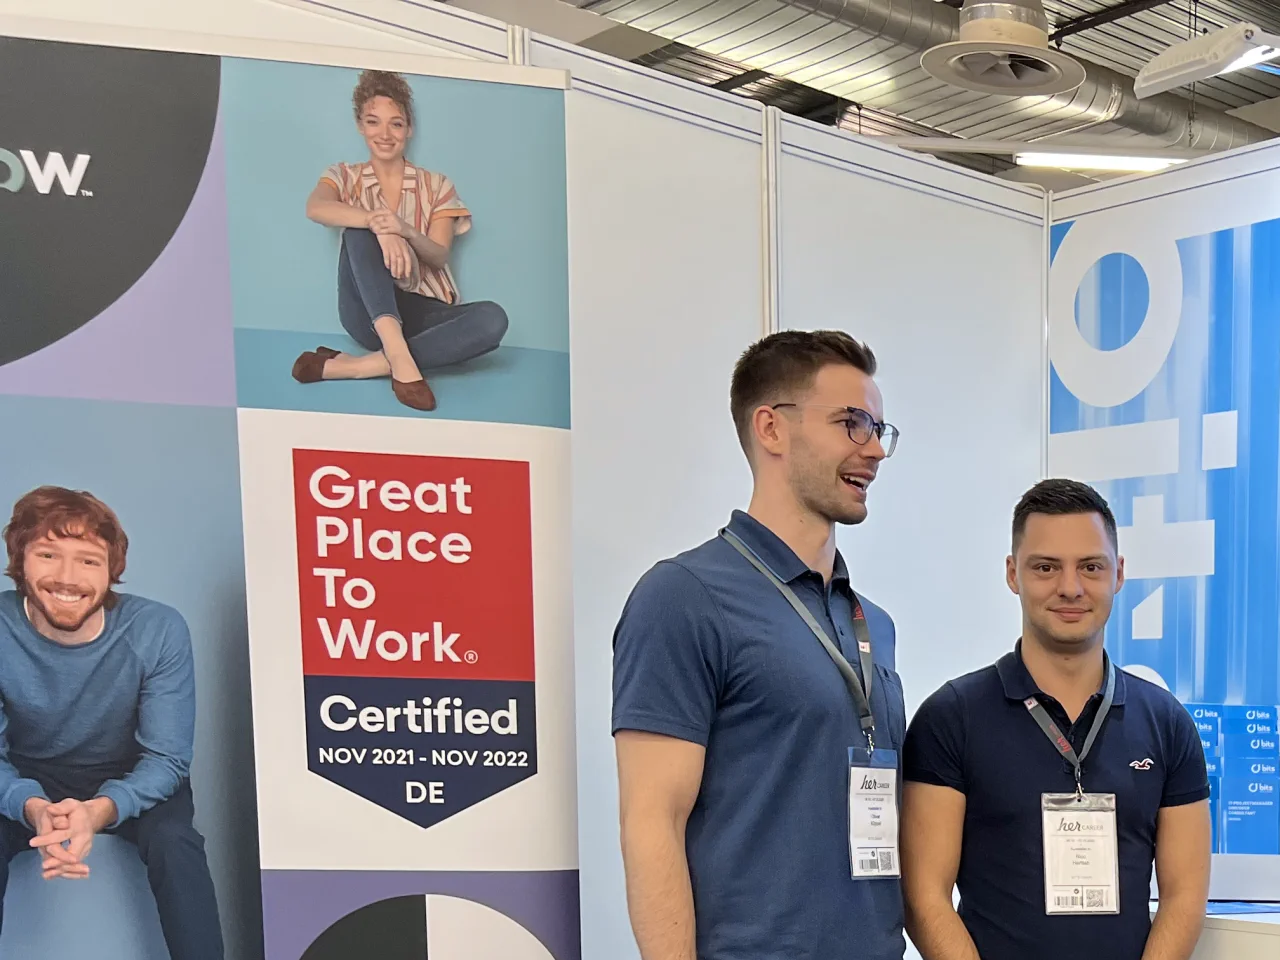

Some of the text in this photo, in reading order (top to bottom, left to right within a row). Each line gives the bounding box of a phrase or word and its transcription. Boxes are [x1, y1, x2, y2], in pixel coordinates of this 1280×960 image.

[309, 465, 472, 514] Great
[316, 516, 472, 564] Place
[313, 567, 376, 609] To
[319, 694, 518, 736] Certified
[1256, 711, 1270, 719] bits
[1199, 723, 1213, 731] bits
[1261, 740, 1275, 748] bits
[319, 748, 367, 765] NOV
[372, 748, 415, 766] 2021
[432, 750, 479, 766] NOV
[483, 750, 529, 768] 2022
[1262, 764, 1276, 772] bits
[405, 781, 445, 804] DE
